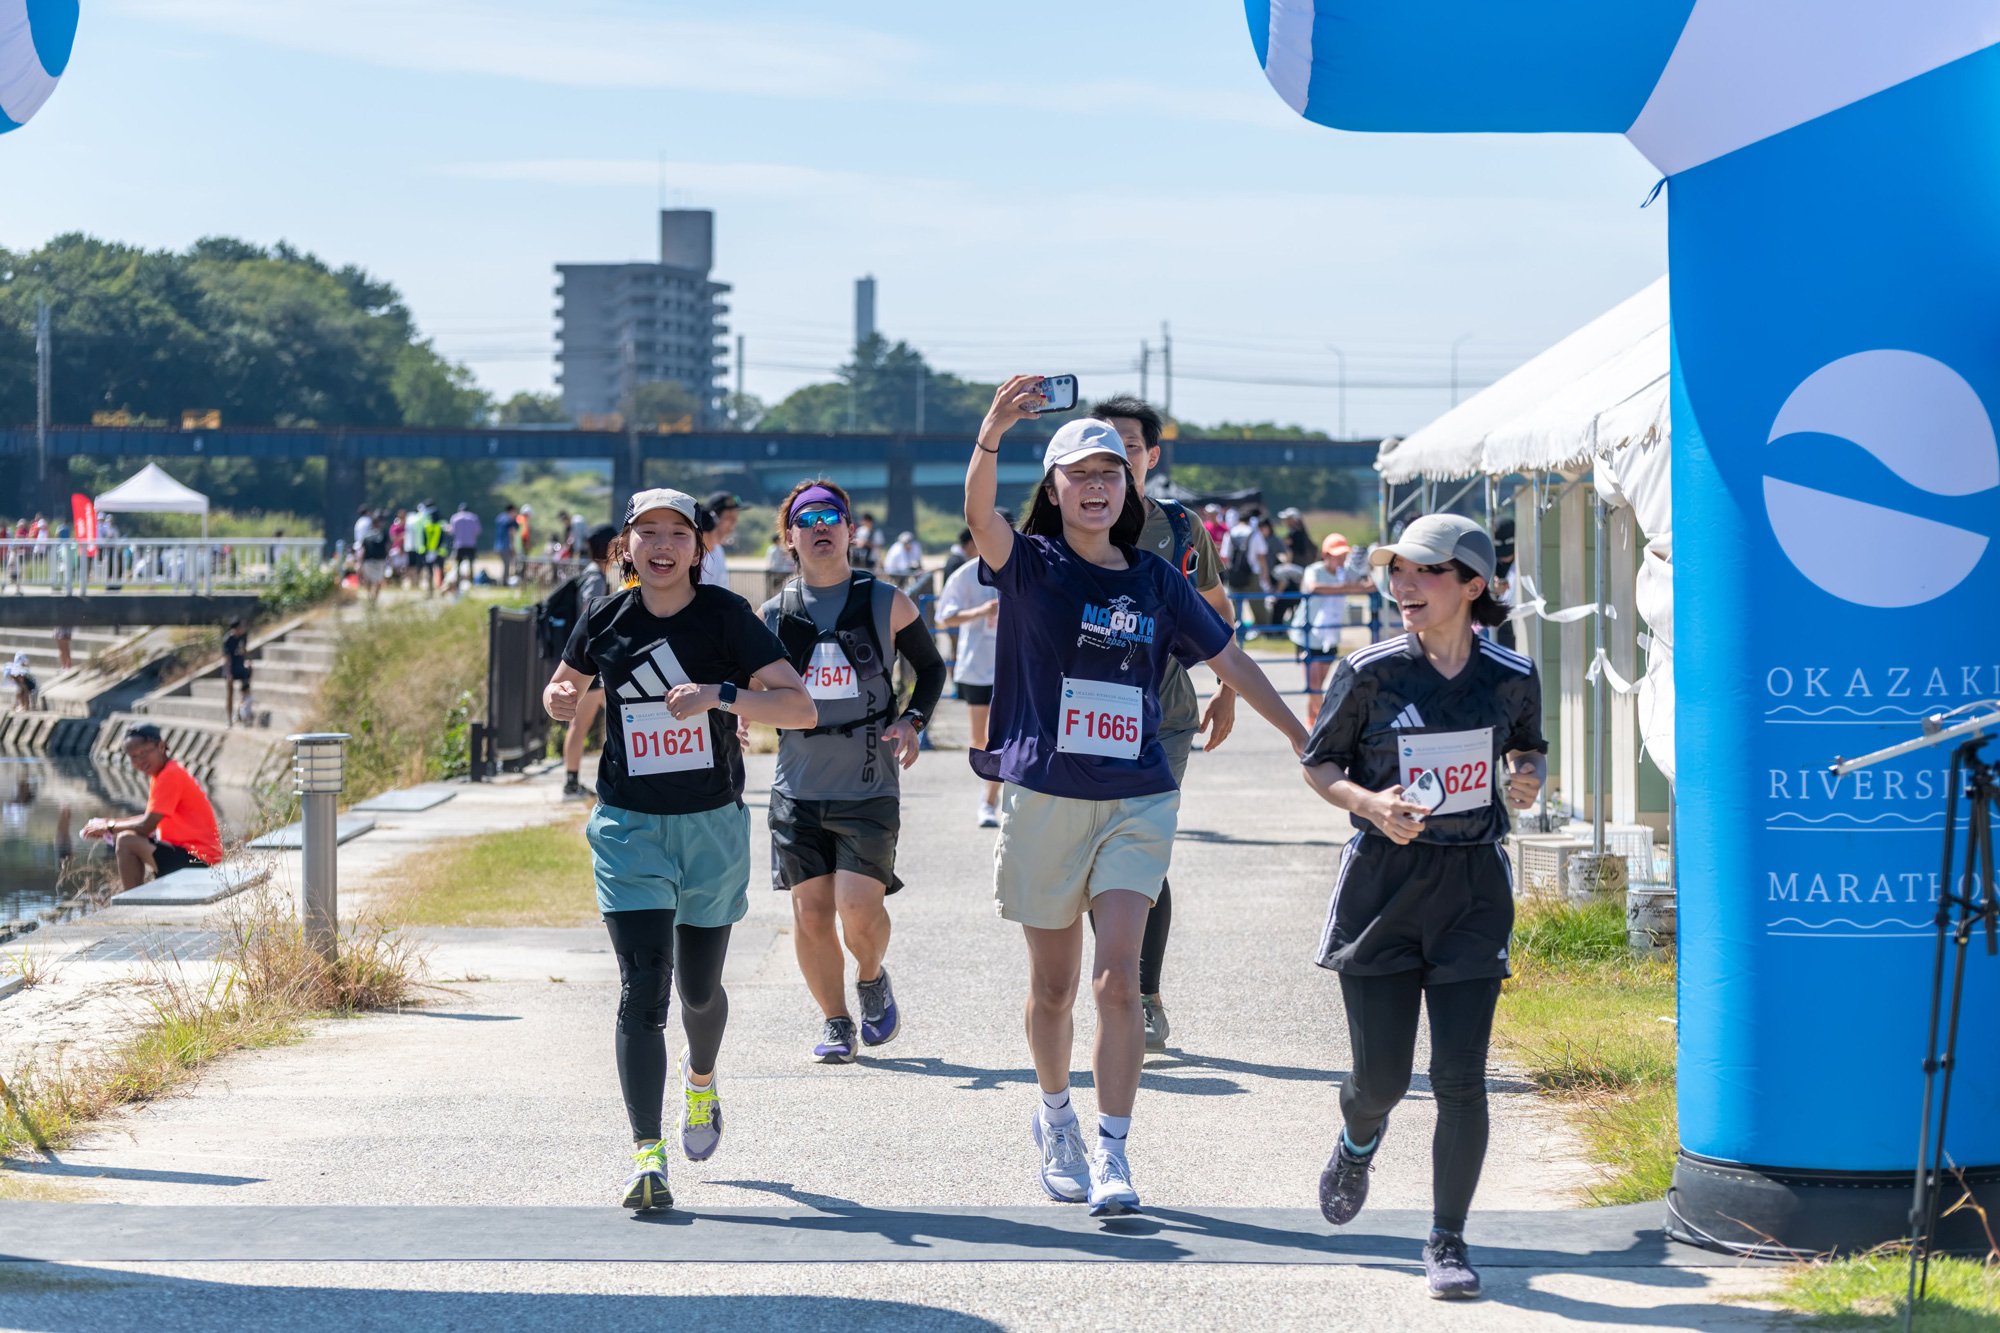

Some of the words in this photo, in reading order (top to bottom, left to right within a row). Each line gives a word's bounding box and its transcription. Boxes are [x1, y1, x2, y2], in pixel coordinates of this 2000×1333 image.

[1082, 603, 1155, 636] NAGOYA
[1105, 637, 1127, 648] 2026
[804, 666, 852, 687] F1547
[1767, 665, 2000, 697] OKAZAKI
[1066, 708, 1139, 743] F1665
[632, 726, 704, 758] D1621
[1409, 761, 1488, 797] 622
